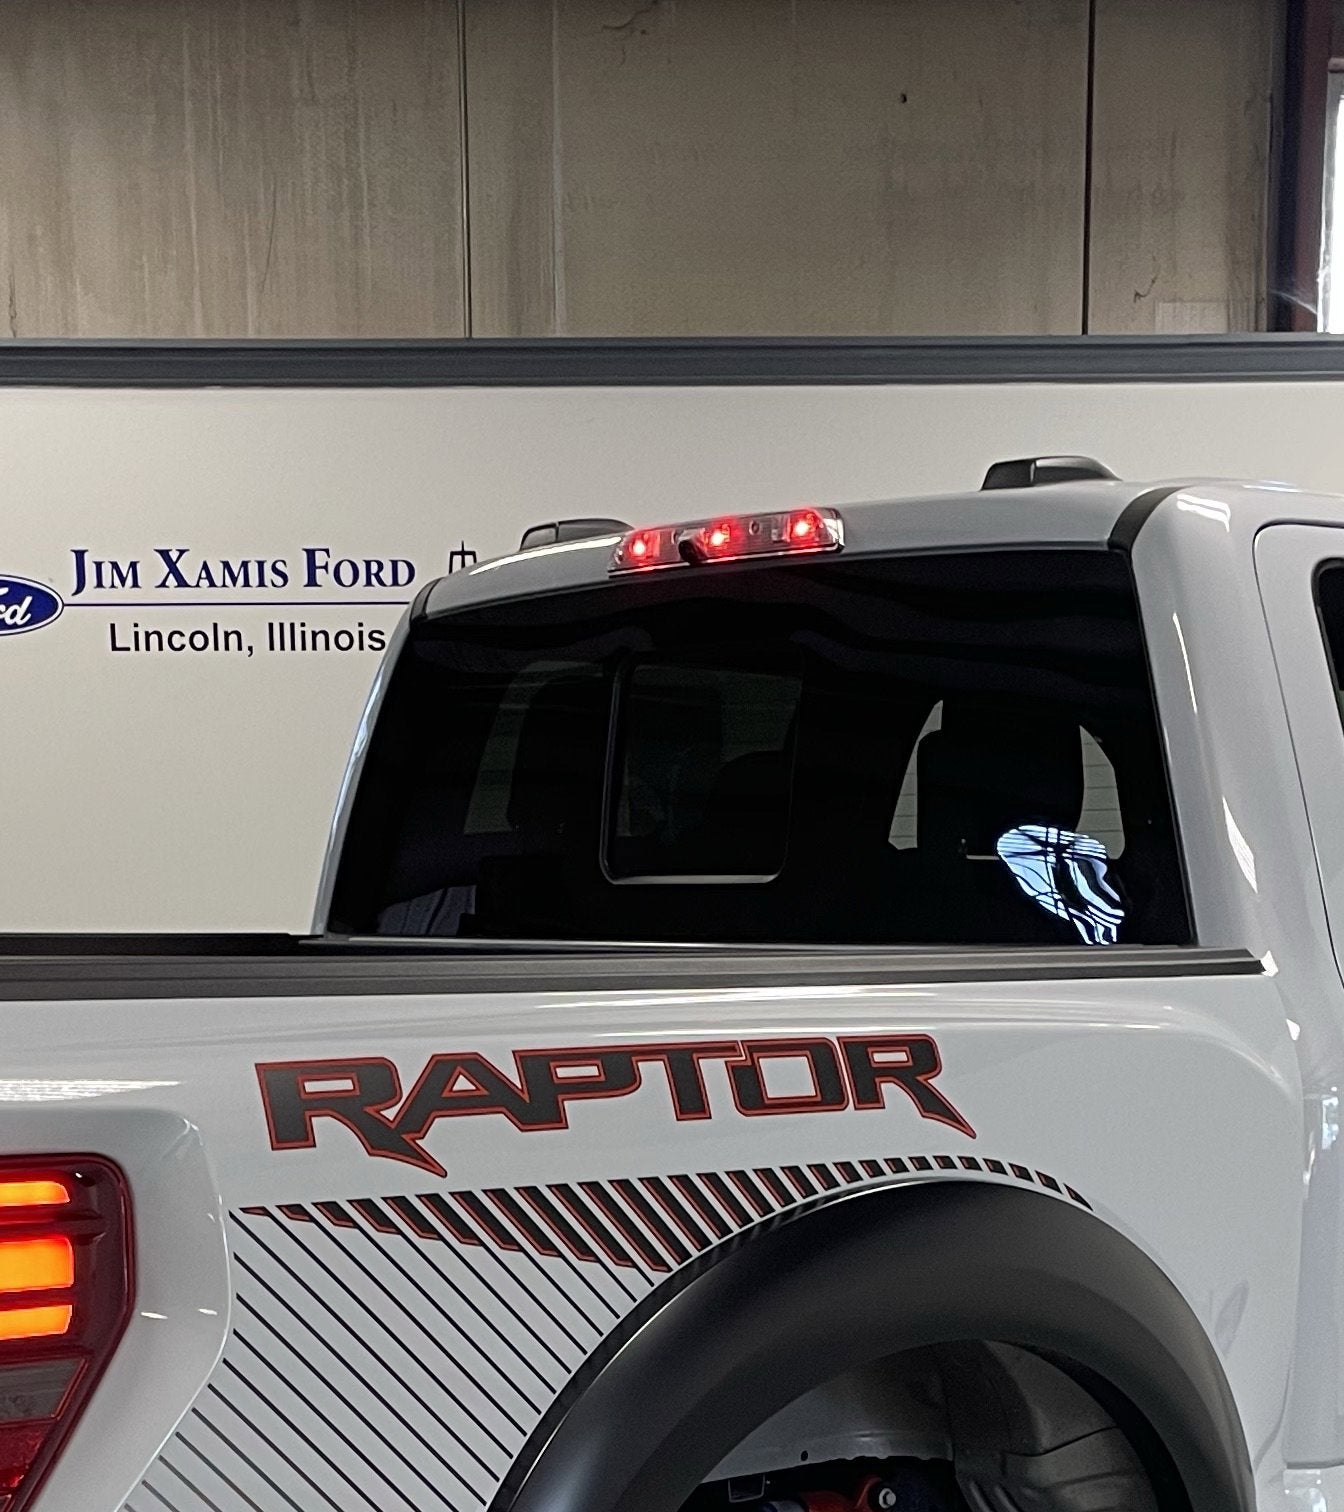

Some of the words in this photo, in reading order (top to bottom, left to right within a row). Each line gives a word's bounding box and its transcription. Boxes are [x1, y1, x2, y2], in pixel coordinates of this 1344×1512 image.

[70, 548, 141, 596] JIM
[155, 548, 289, 589] XAMIS
[302, 547, 416, 589] FORD
[109, 622, 254, 657] Lincoln,
[268, 621, 386, 652] Illinois
[256, 1034, 976, 1177] RAPTOR
